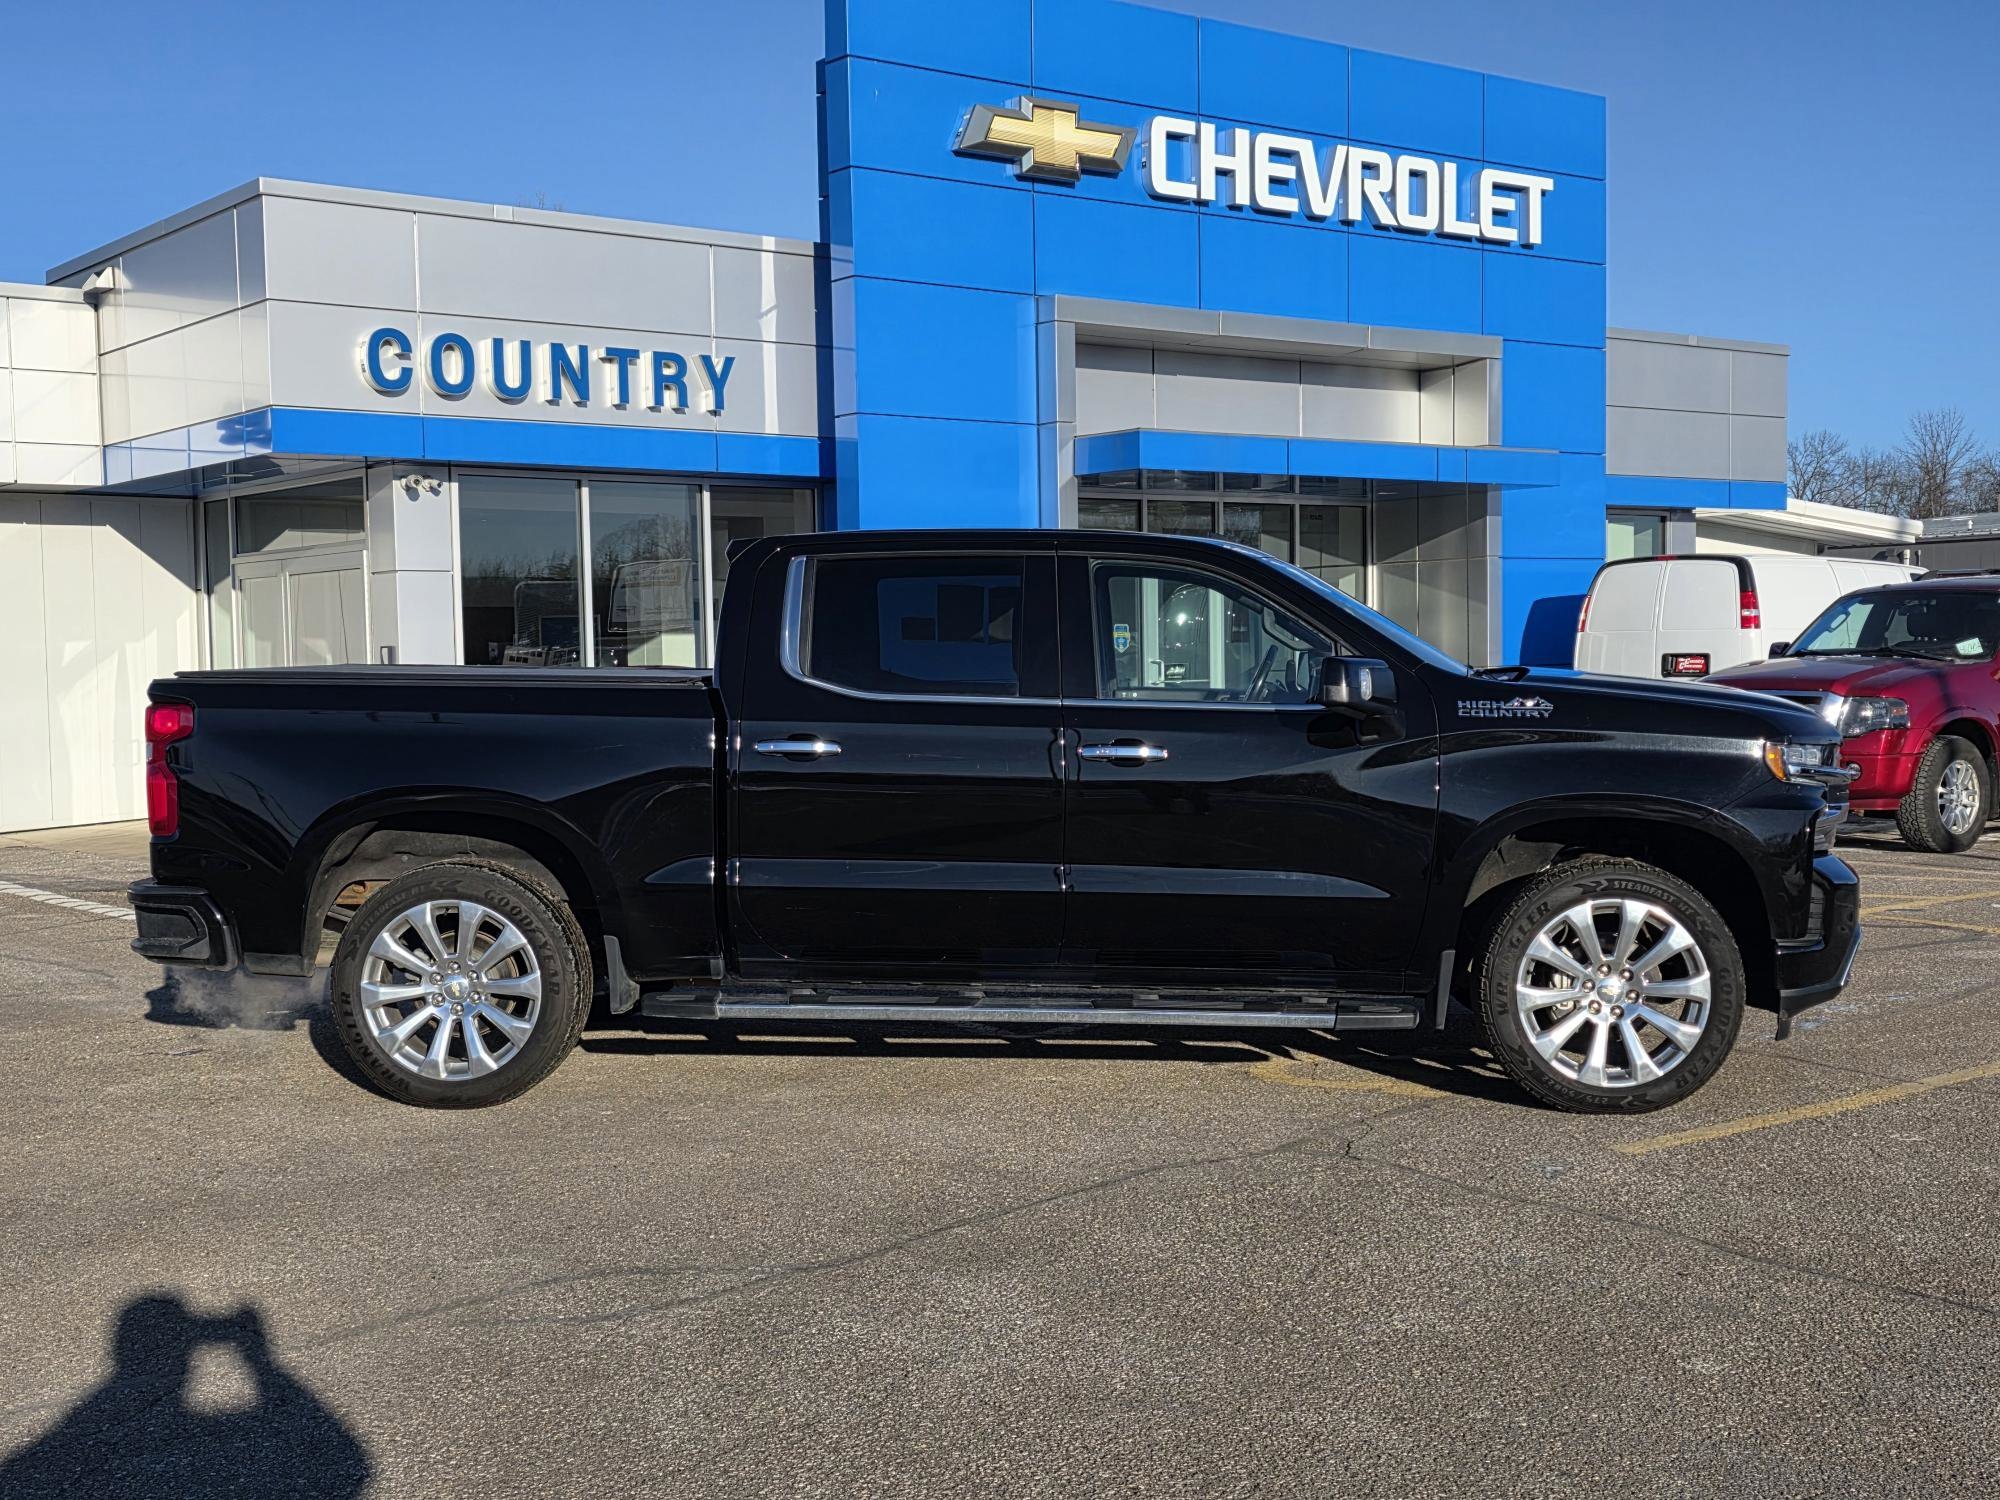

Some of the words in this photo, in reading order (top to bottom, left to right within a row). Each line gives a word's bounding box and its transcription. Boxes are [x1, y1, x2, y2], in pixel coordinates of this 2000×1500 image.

[1147, 115, 1554, 246] CHEVROLET
[364, 327, 736, 415] COUNTRY
[1457, 700, 1505, 709] HIGH
[1457, 709, 1553, 718] COUNTRY
[1613, 880, 1676, 903] STEADFAST
[484, 889, 560, 996] GOODYEAR
[1496, 901, 1551, 1016] WRANGLER
